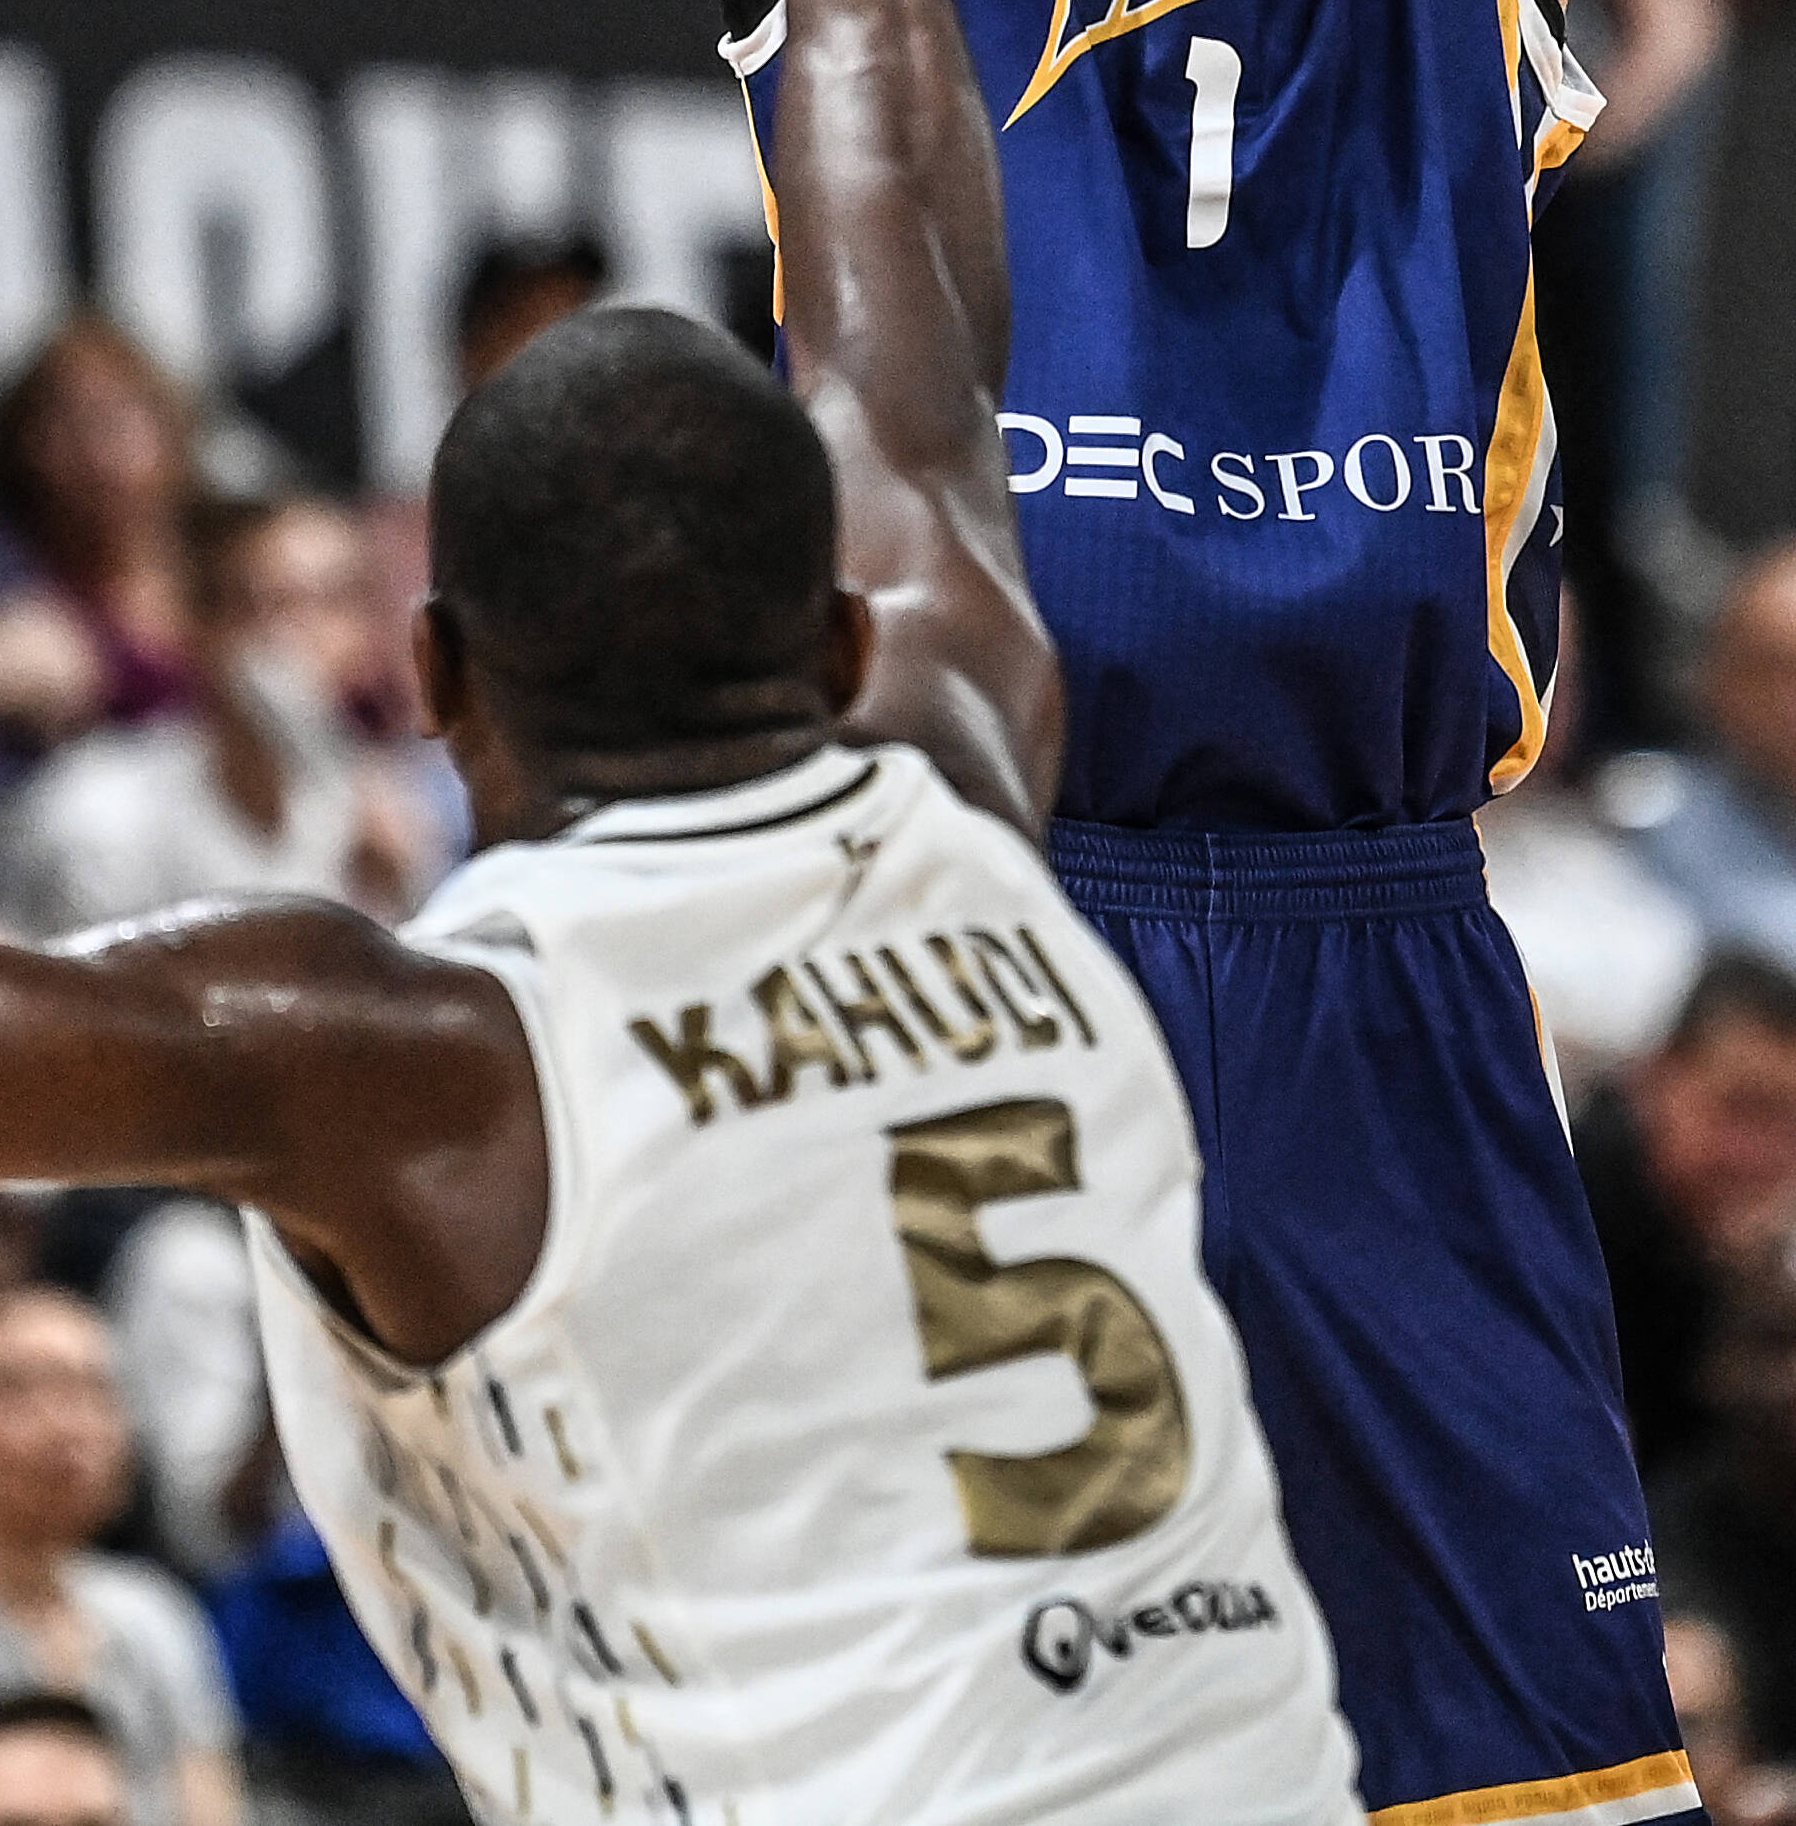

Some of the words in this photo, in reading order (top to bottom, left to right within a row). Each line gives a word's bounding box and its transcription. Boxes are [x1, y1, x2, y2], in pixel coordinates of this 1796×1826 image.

[1185, 35, 1243, 249] 1
[996, 411, 1196, 516] DEC
[1209, 432, 1482, 521] SPOR
[627, 922, 1098, 1127] KAHUDI
[885, 1093, 1194, 1559] 5
